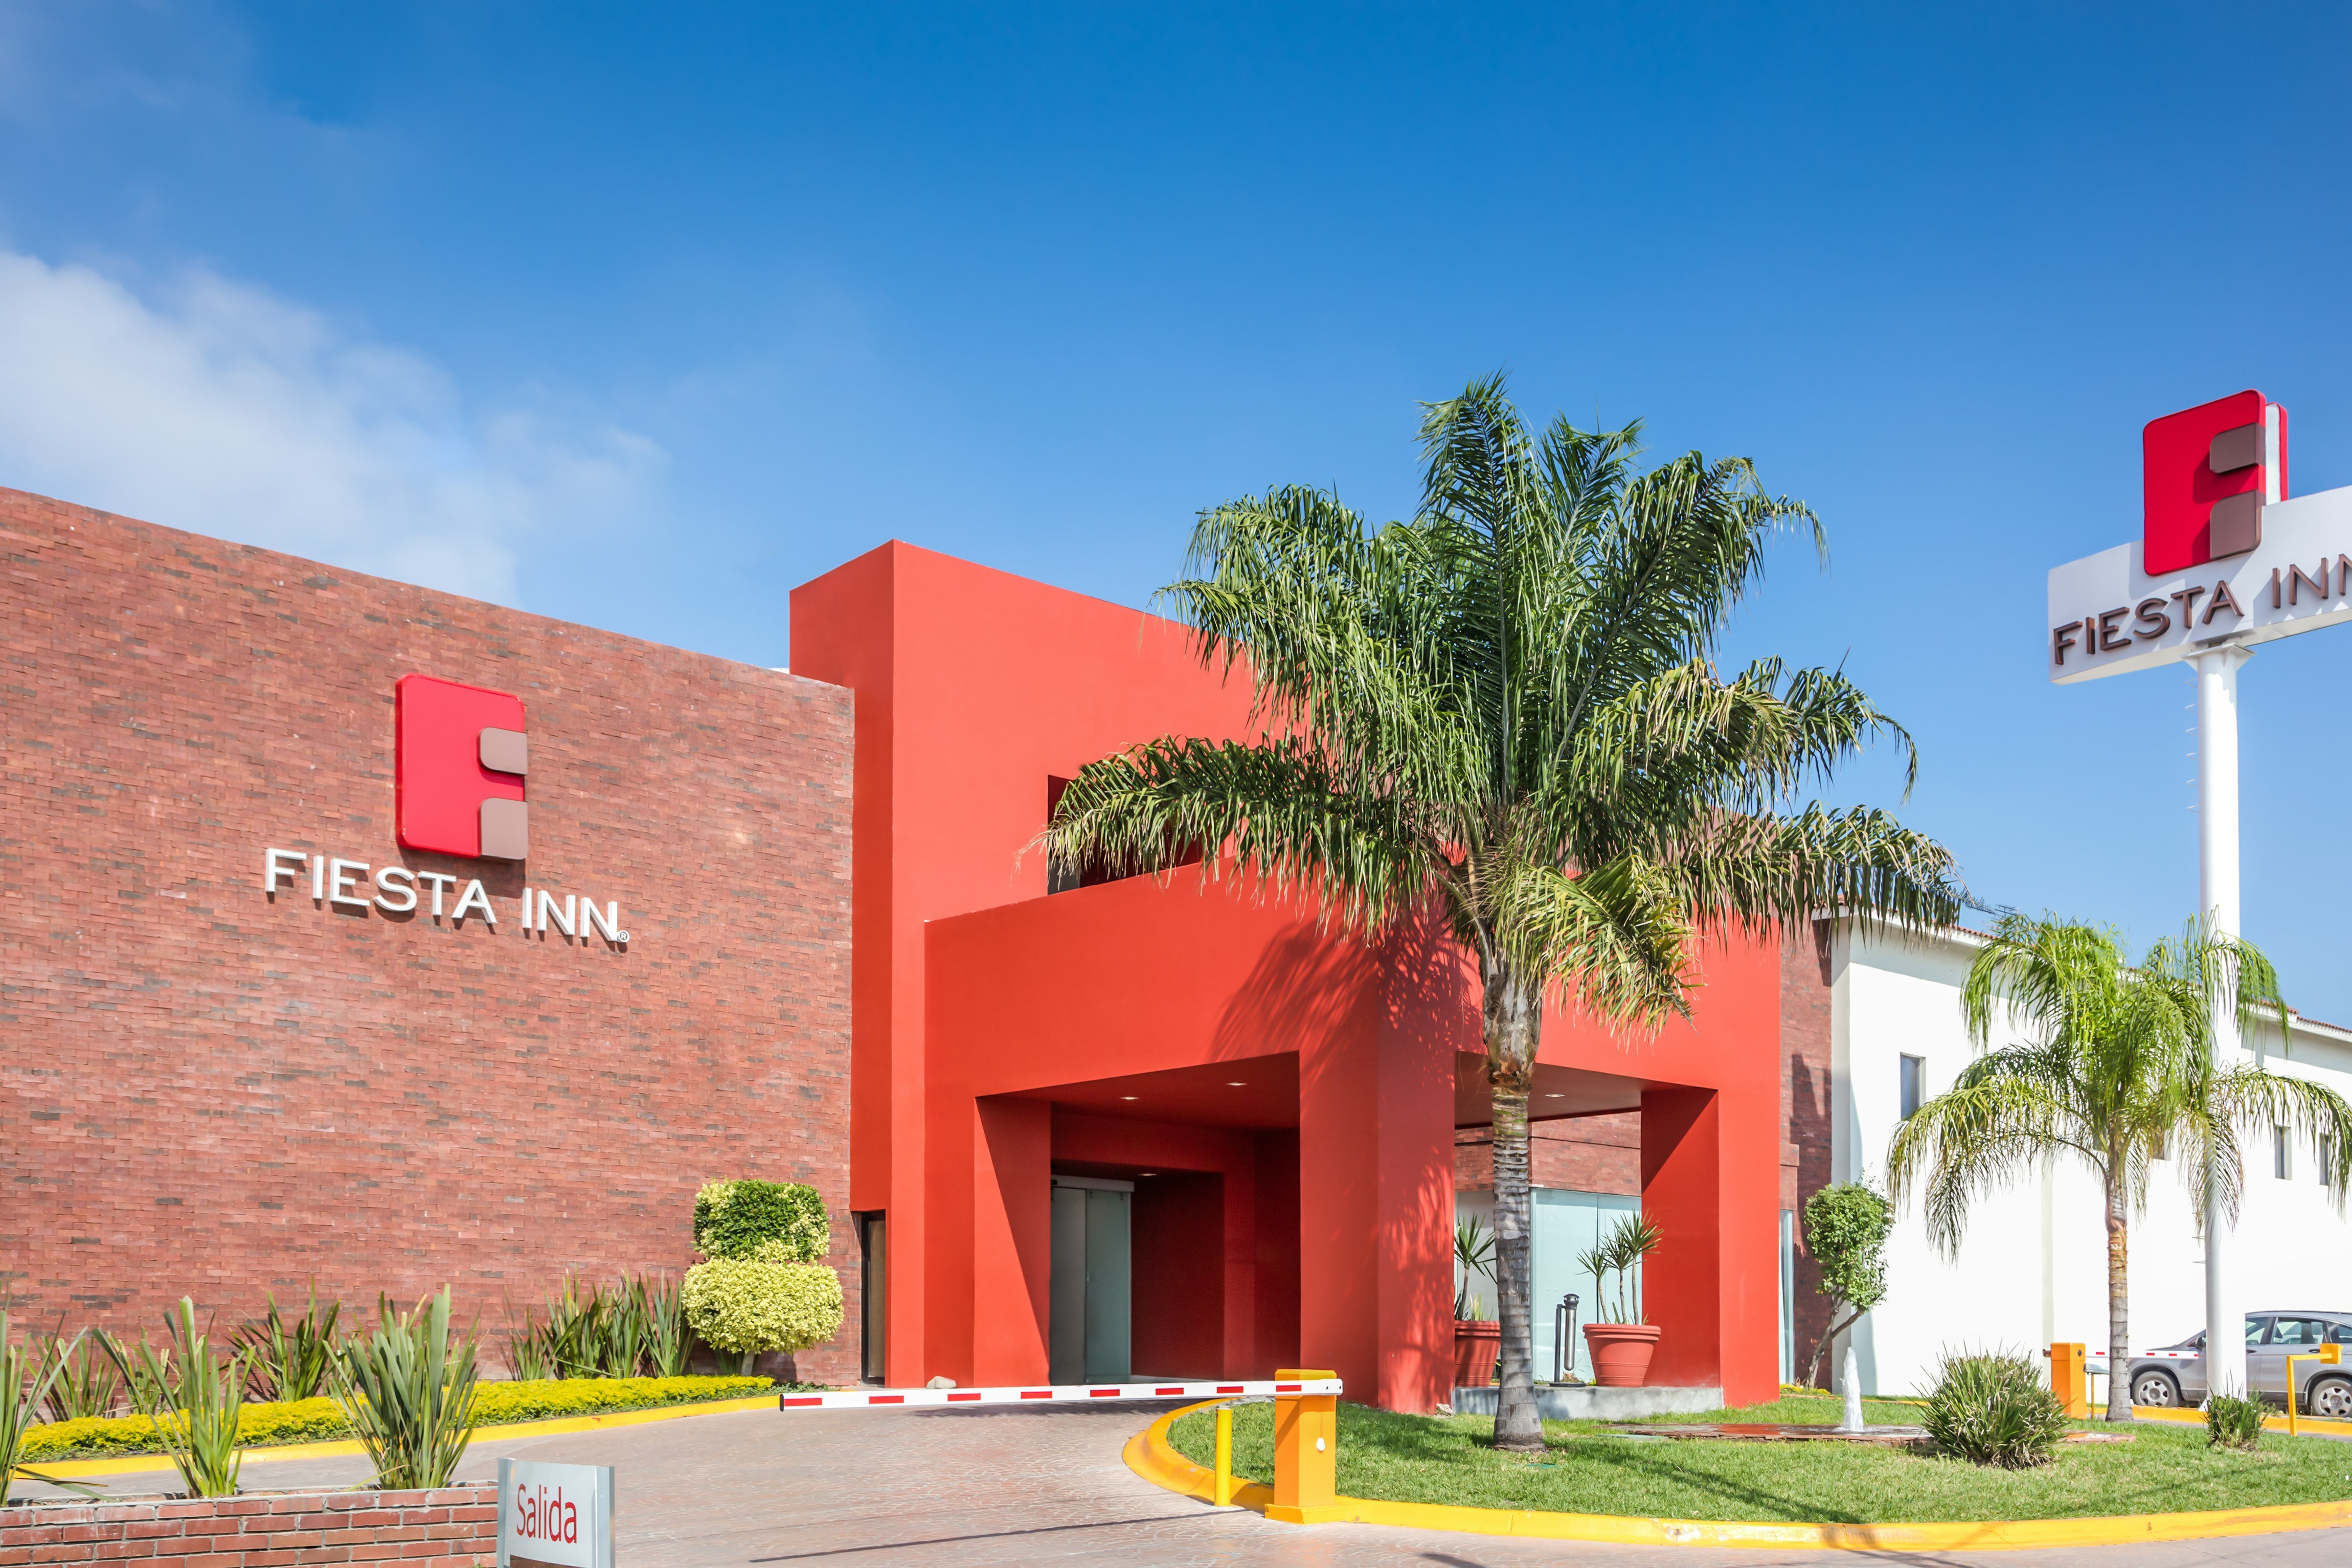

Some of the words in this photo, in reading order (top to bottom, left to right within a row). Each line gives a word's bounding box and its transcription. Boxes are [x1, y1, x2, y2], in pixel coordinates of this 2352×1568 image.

[2053, 580, 2245, 665] FIESTA
[265, 847, 497, 924] FIESTA
[516, 1484, 577, 1543] Salida
